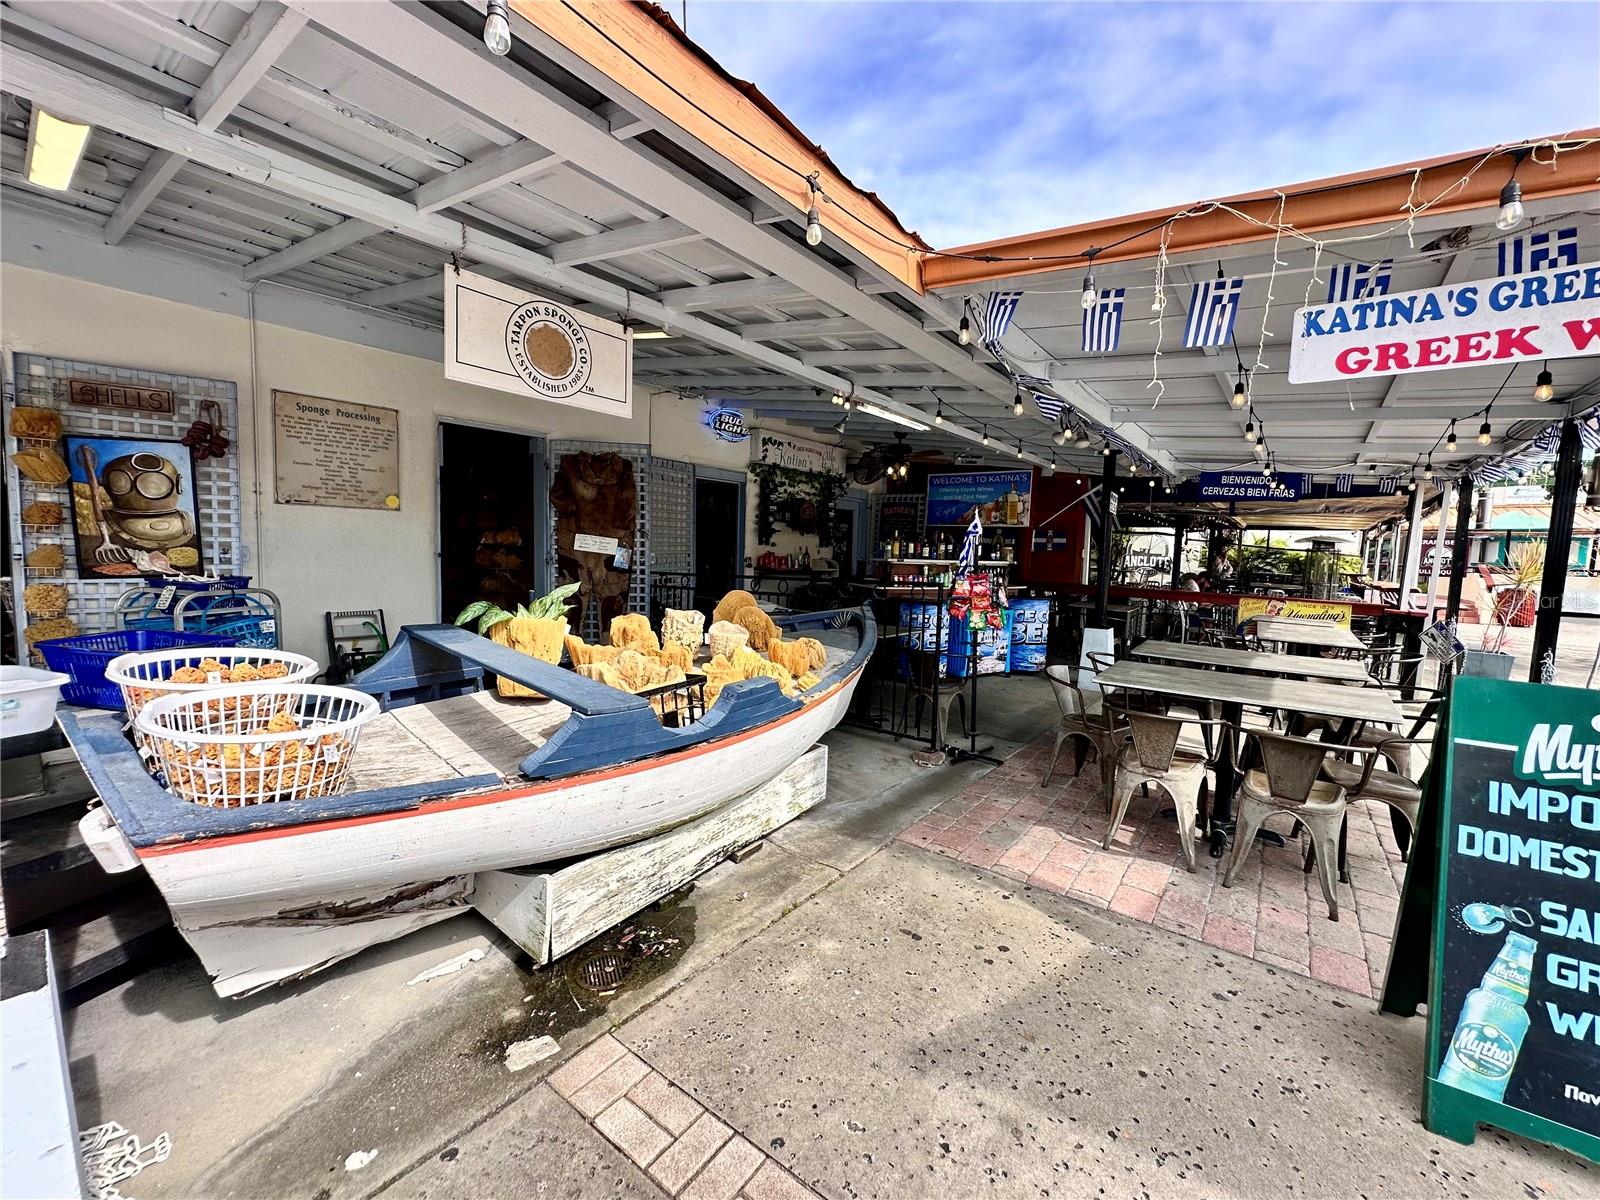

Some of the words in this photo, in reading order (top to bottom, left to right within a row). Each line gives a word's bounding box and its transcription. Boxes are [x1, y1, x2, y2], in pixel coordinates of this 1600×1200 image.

[1301, 287, 1478, 337] KATINA'S
[511, 306, 541, 345] TARPON
[543, 306, 584, 345] SPONGE
[1335, 325, 1543, 374] GREEK
[515, 352, 568, 393] ESTABLISHED
[79, 385, 164, 410] SHELLS
[295, 402, 331, 417] Sponge
[336, 408, 381, 425] Processing
[721, 414, 744, 426] BUD
[715, 422, 751, 435] LIGHT
[933, 476, 974, 485] WELCOME
[976, 475, 987, 483] TO
[989, 473, 1028, 482] KATINA'S
[1221, 475, 1278, 485] BIENVENIDO
[1202, 486, 1246, 497] CERVEZAS
[1247, 488, 1267, 497] BIEN
[1455, 1027, 1513, 1066] Mythos
